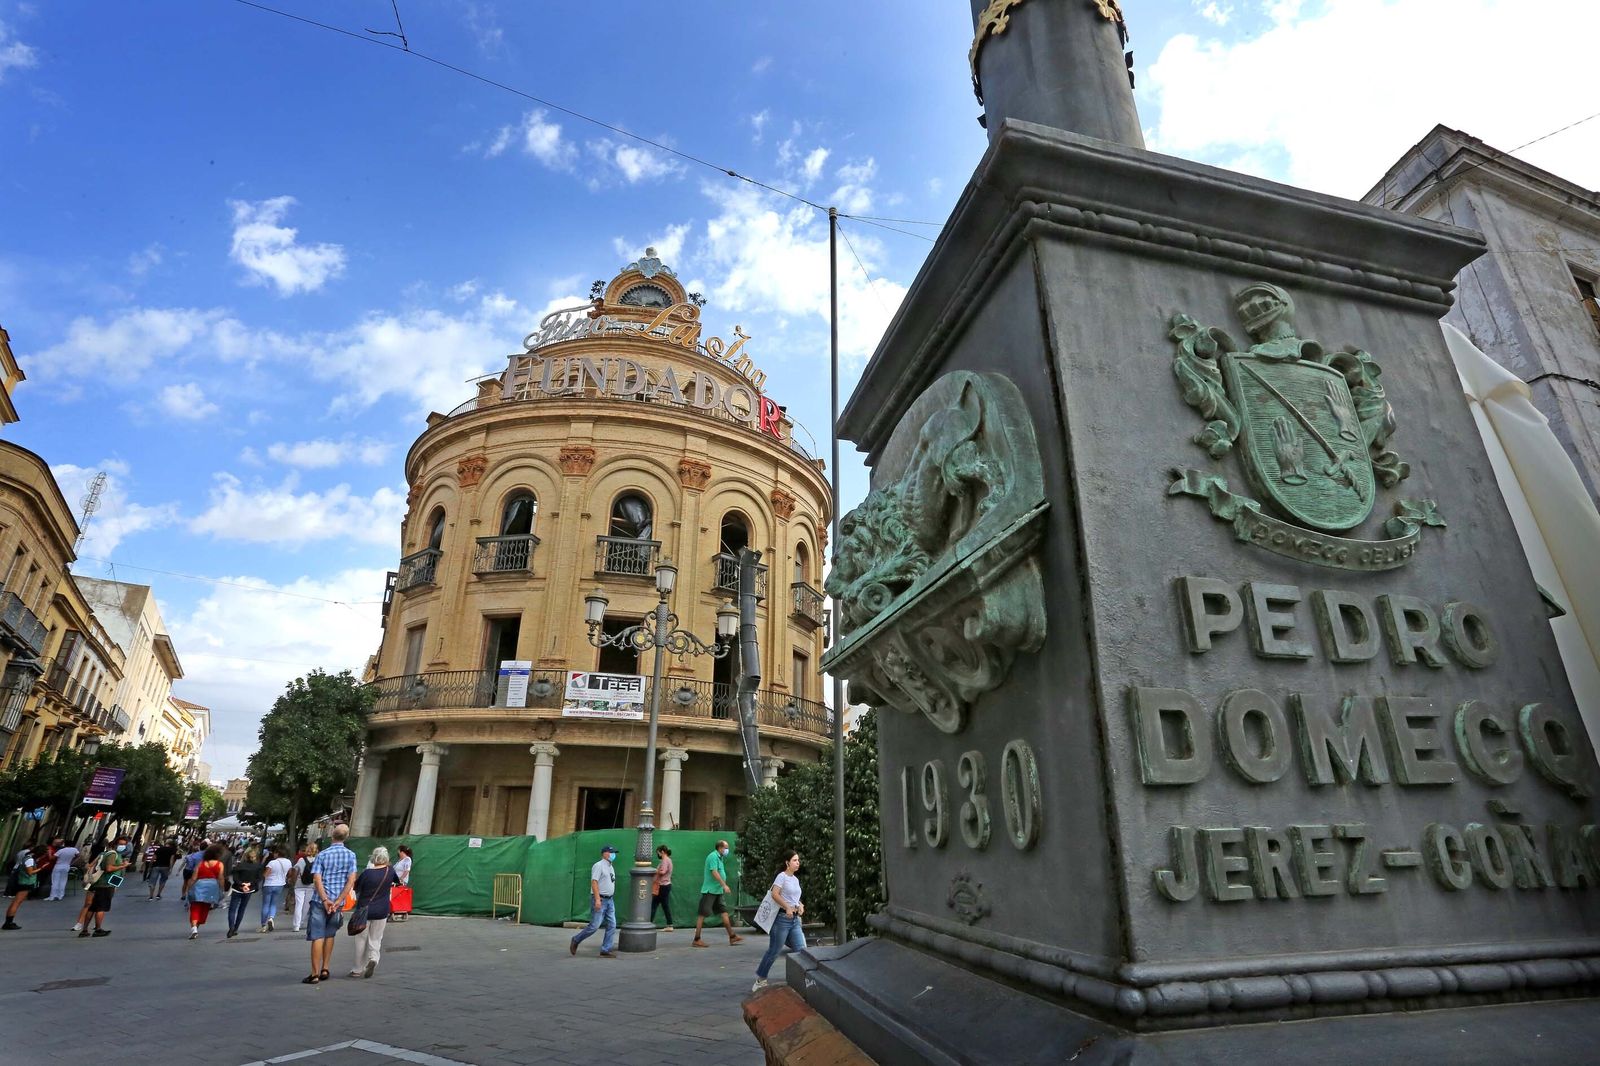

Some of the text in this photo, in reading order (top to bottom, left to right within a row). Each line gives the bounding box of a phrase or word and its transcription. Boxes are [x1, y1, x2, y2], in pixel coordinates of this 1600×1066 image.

[523, 302, 613, 350] Fino
[623, 303, 702, 348] La
[502, 353, 786, 441] FUNDADOR
[1175, 575, 1499, 669] PEDRO
[1128, 685, 1593, 799] DOMECQ
[900, 739, 1043, 850] 1930
[1153, 800, 1600, 901] JEREZ-COÑA
